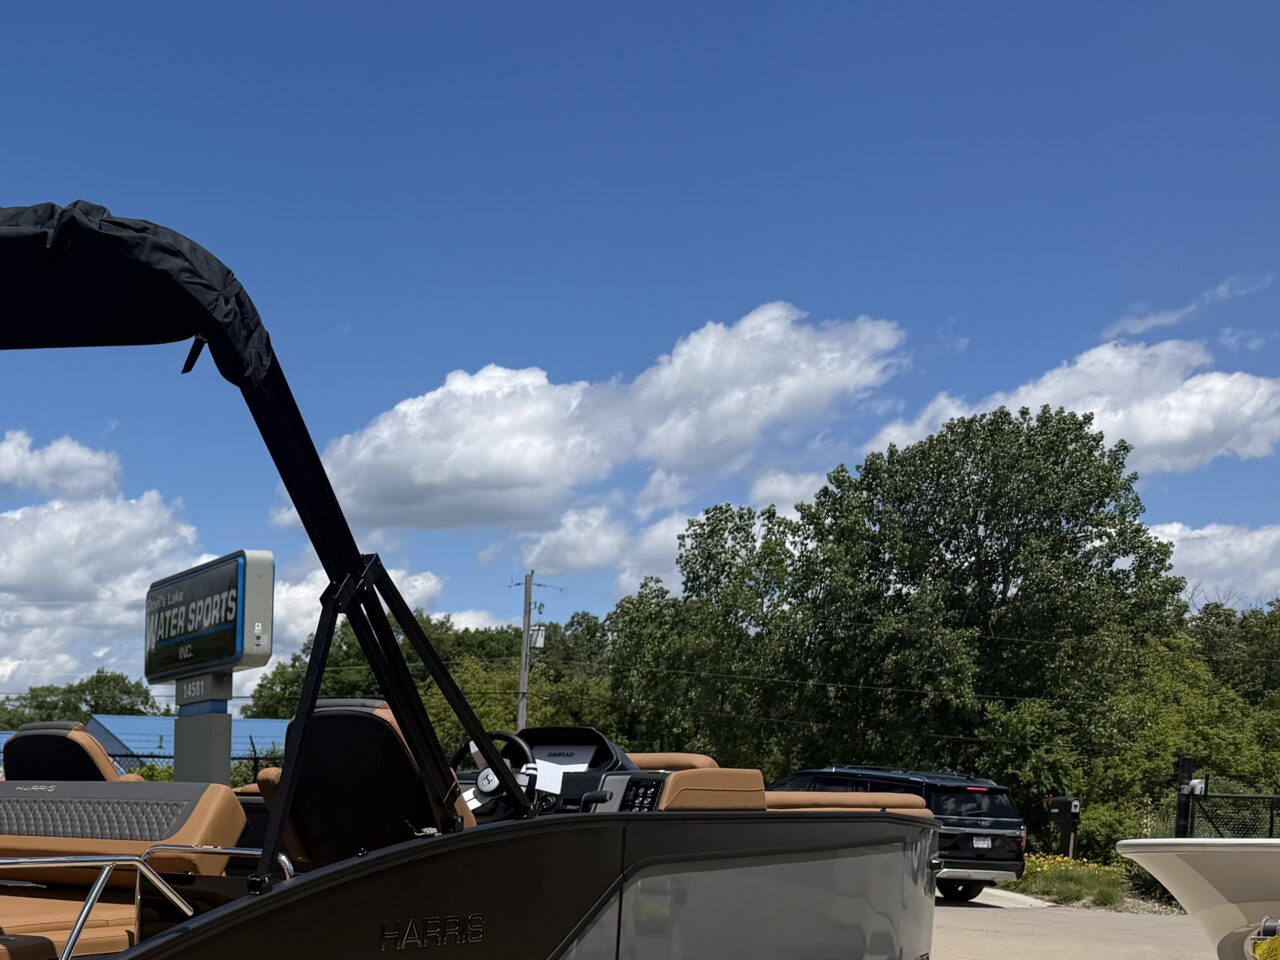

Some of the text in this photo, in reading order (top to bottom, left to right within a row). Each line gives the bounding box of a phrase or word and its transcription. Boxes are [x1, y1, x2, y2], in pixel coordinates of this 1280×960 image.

[146, 588, 237, 651] WATER SPORTS
[183, 680, 205, 698] 14581
[380, 912, 484, 951] HARRIS
